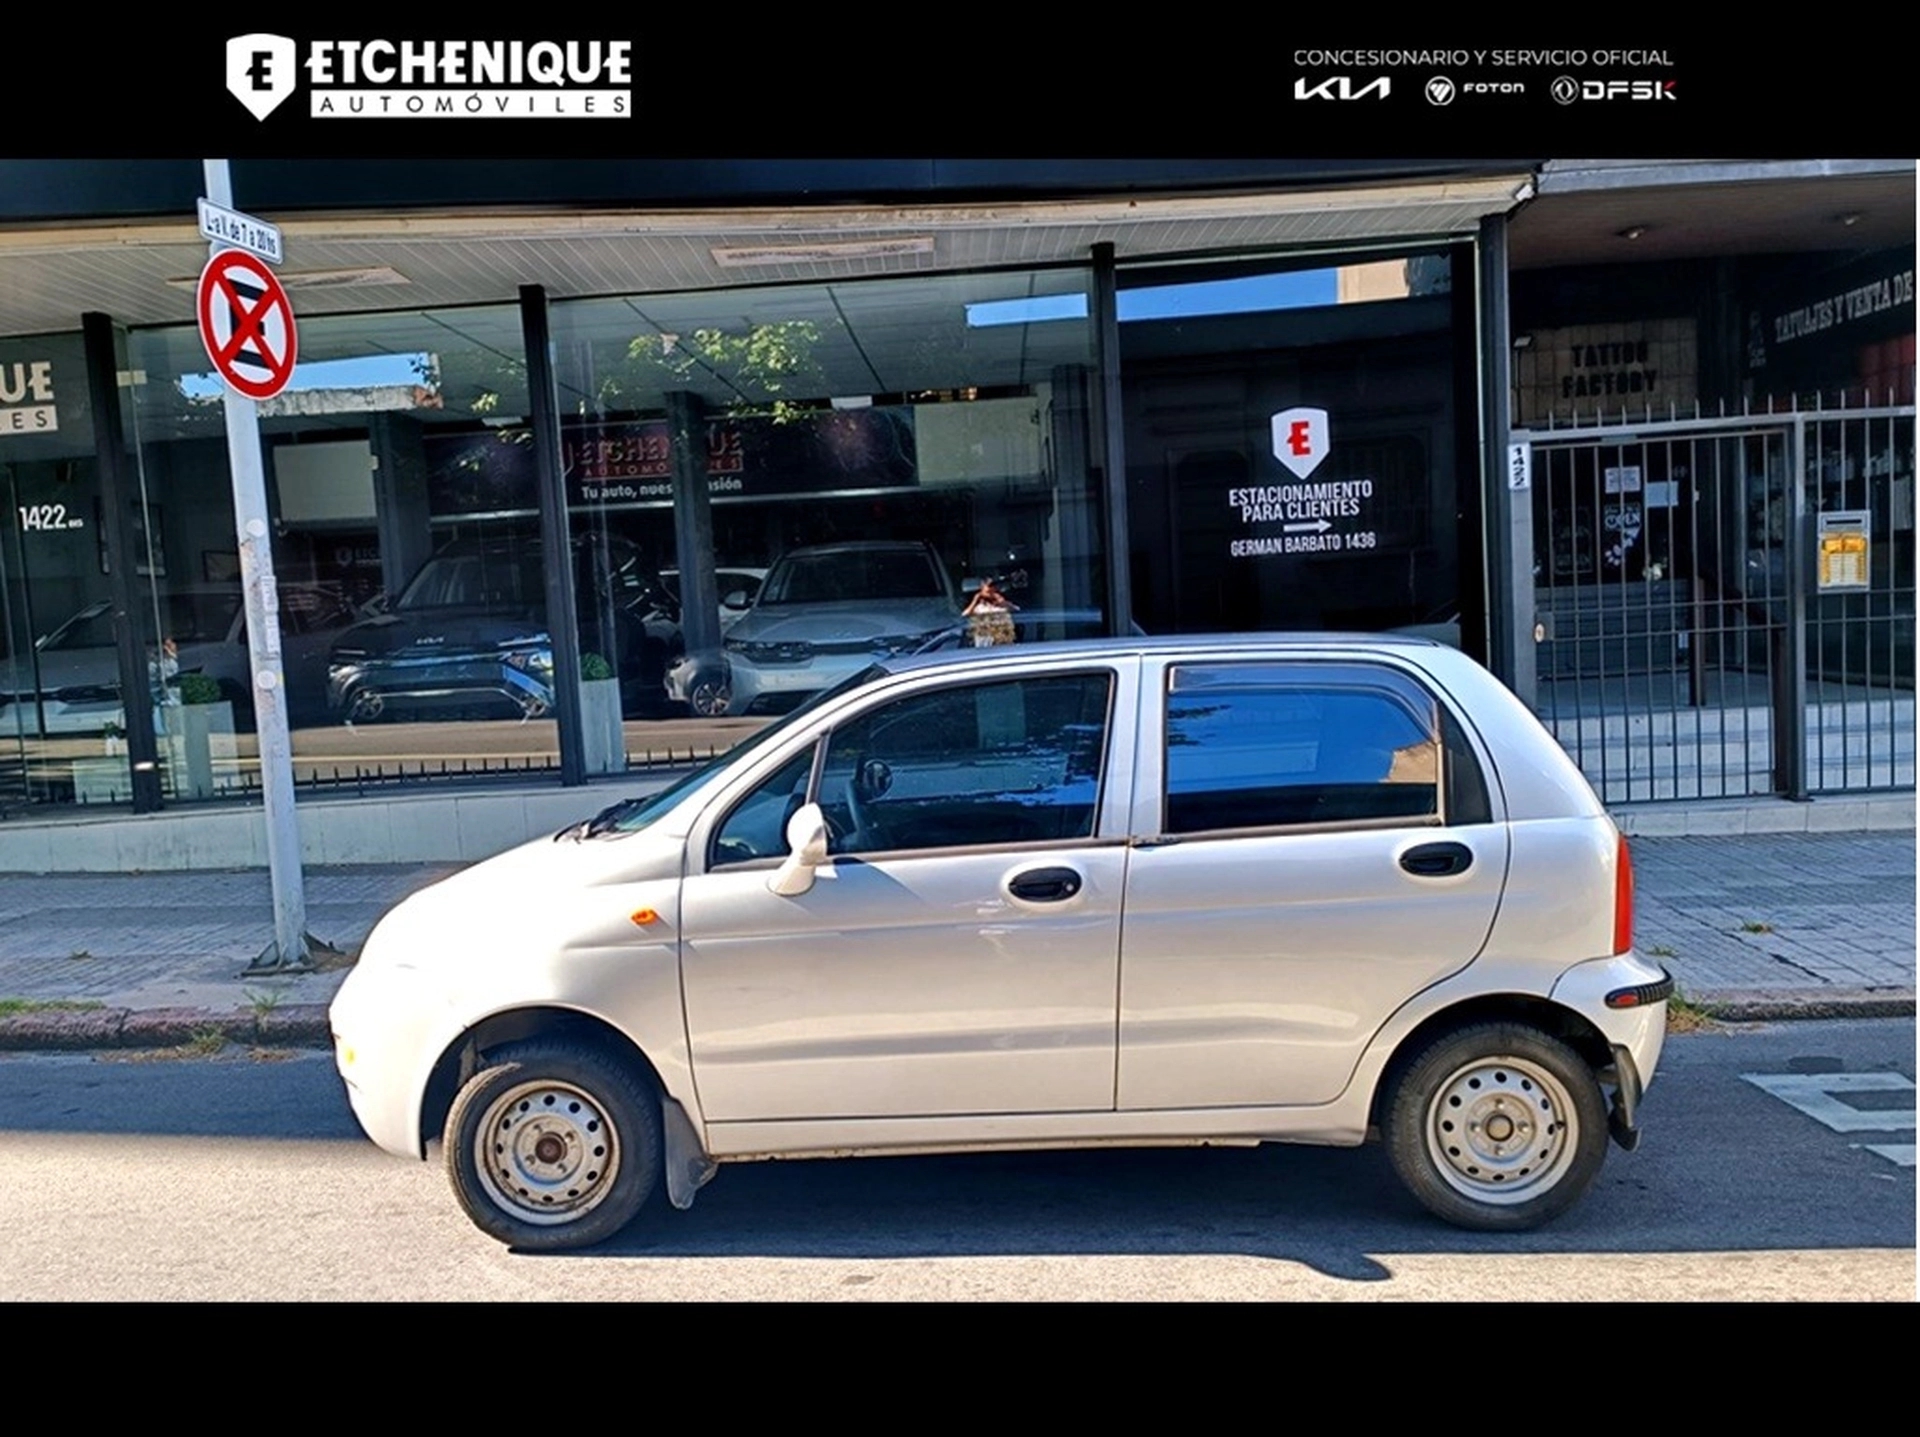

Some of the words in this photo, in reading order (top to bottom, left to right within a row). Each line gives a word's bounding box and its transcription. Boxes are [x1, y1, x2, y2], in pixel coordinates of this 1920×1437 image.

[1834, 294, 1845, 325] Y
[1562, 369, 1657, 398] FACTORY
[581, 486, 598, 499] Tu
[601, 485, 638, 498] auto,
[639, 482, 674, 496] nues
[1229, 480, 1373, 507] ESTACIONAMIENTO
[19, 503, 67, 531] 1422
[1242, 503, 1284, 523] PARA
[1287, 498, 1360, 519] CLIENTES
[1230, 538, 1282, 557] GERMAN
[1284, 534, 1341, 553] BARBATO
[1345, 532, 1376, 549] 1436
